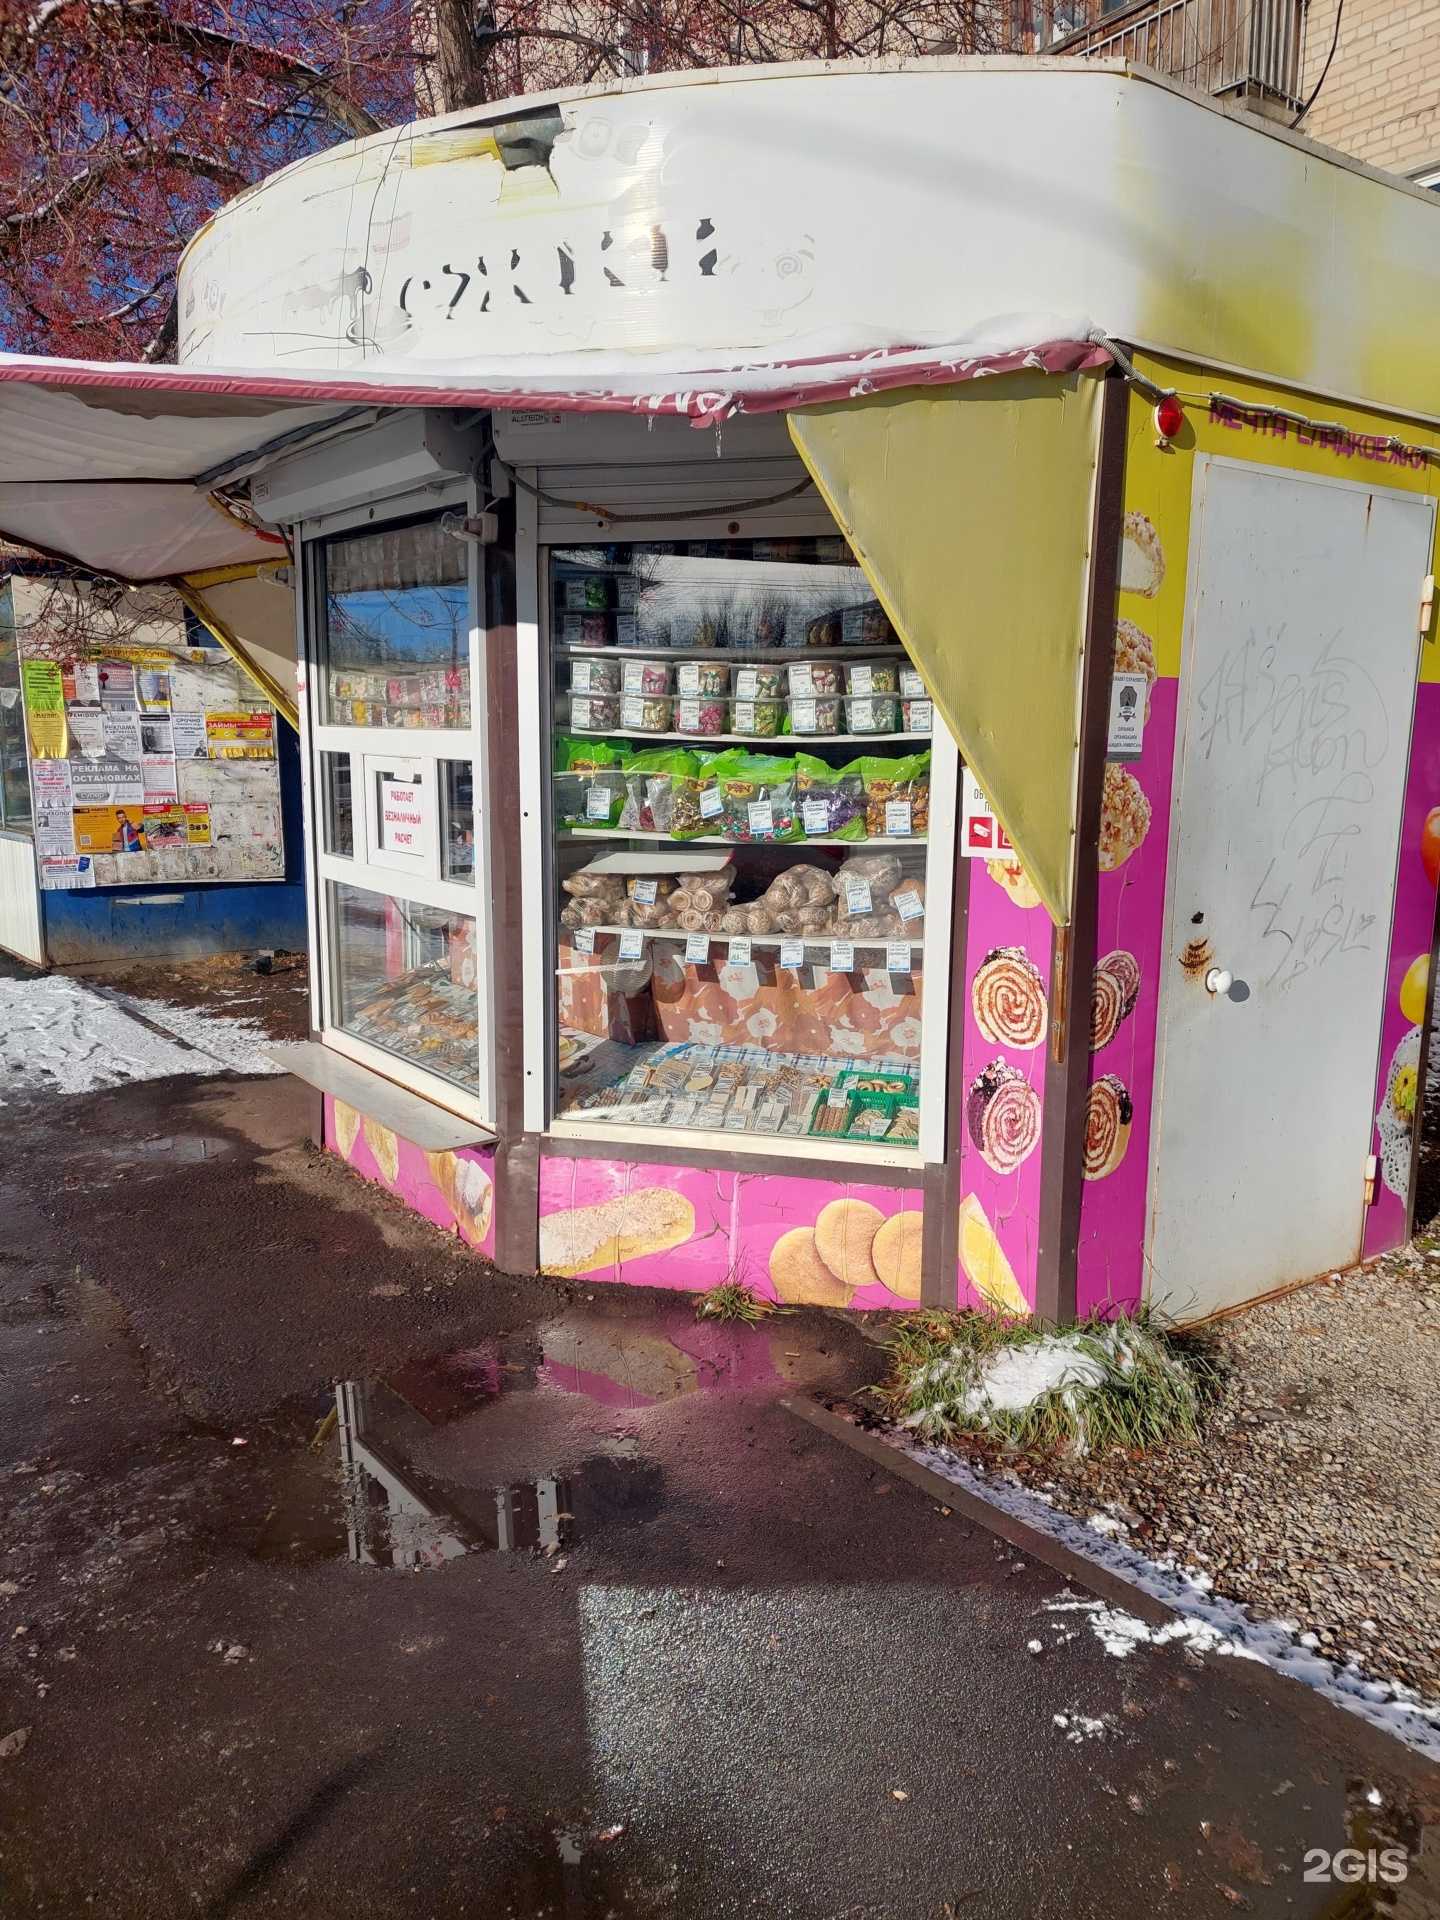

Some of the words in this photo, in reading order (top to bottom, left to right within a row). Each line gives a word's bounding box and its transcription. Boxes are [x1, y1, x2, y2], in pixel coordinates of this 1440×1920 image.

[71, 764, 120, 773] РЕКЛАМА
[125, 764, 139, 772] НА
[72, 774, 141, 783] ОСТАНОВКАХ
[390, 790, 414, 803] РАБОТАЕТ
